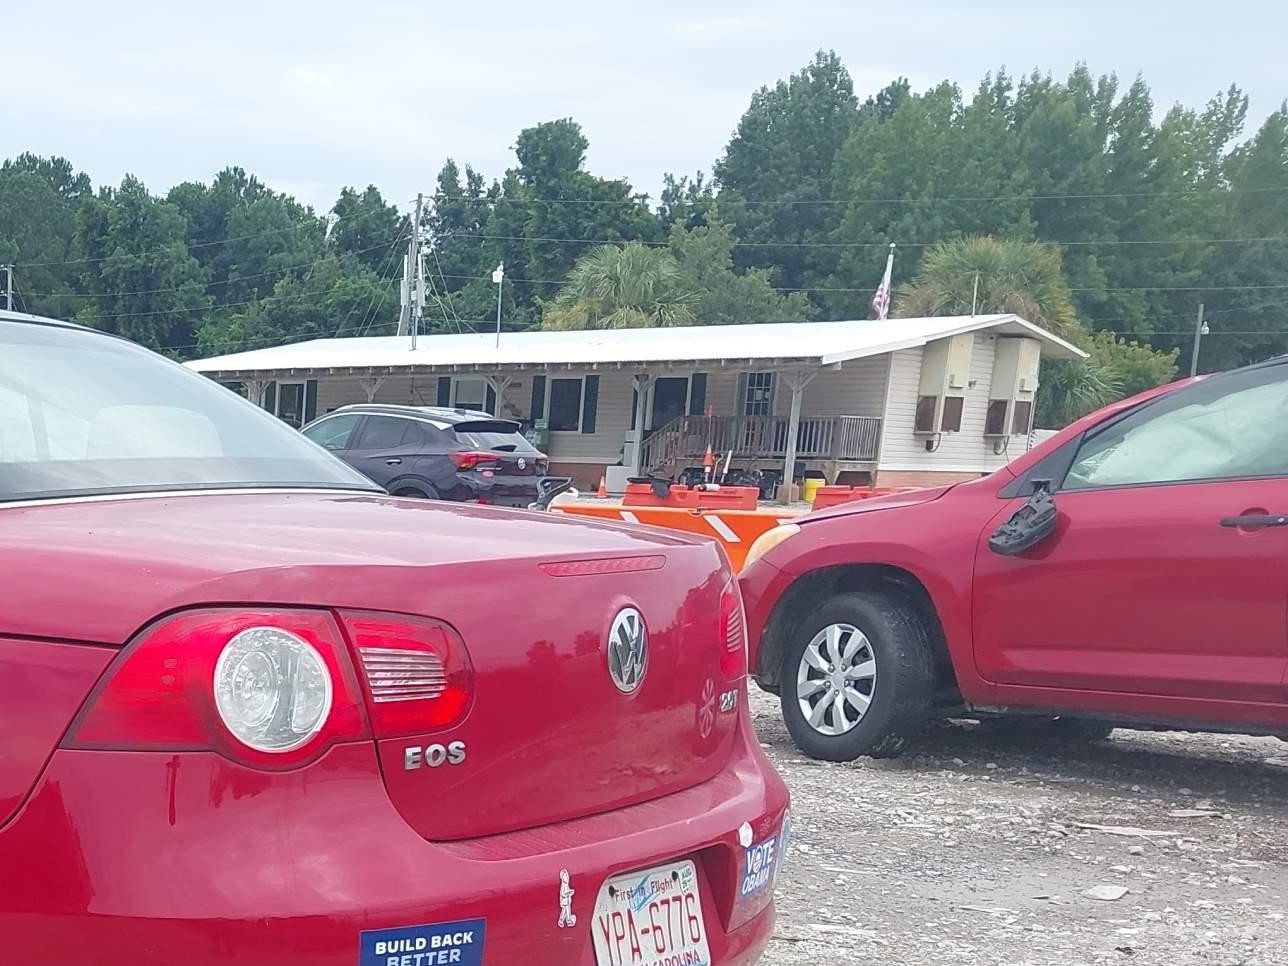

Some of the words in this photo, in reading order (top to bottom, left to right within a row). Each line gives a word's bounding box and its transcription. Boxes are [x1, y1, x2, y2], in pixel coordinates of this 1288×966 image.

[404, 740, 467, 770] EOS
[747, 839, 775, 874] VOTE
[615, 888, 634, 902] First
[651, 878, 673, 894] Flight
[375, 937, 427, 955] BUILD
[431, 931, 473, 948] BACK
